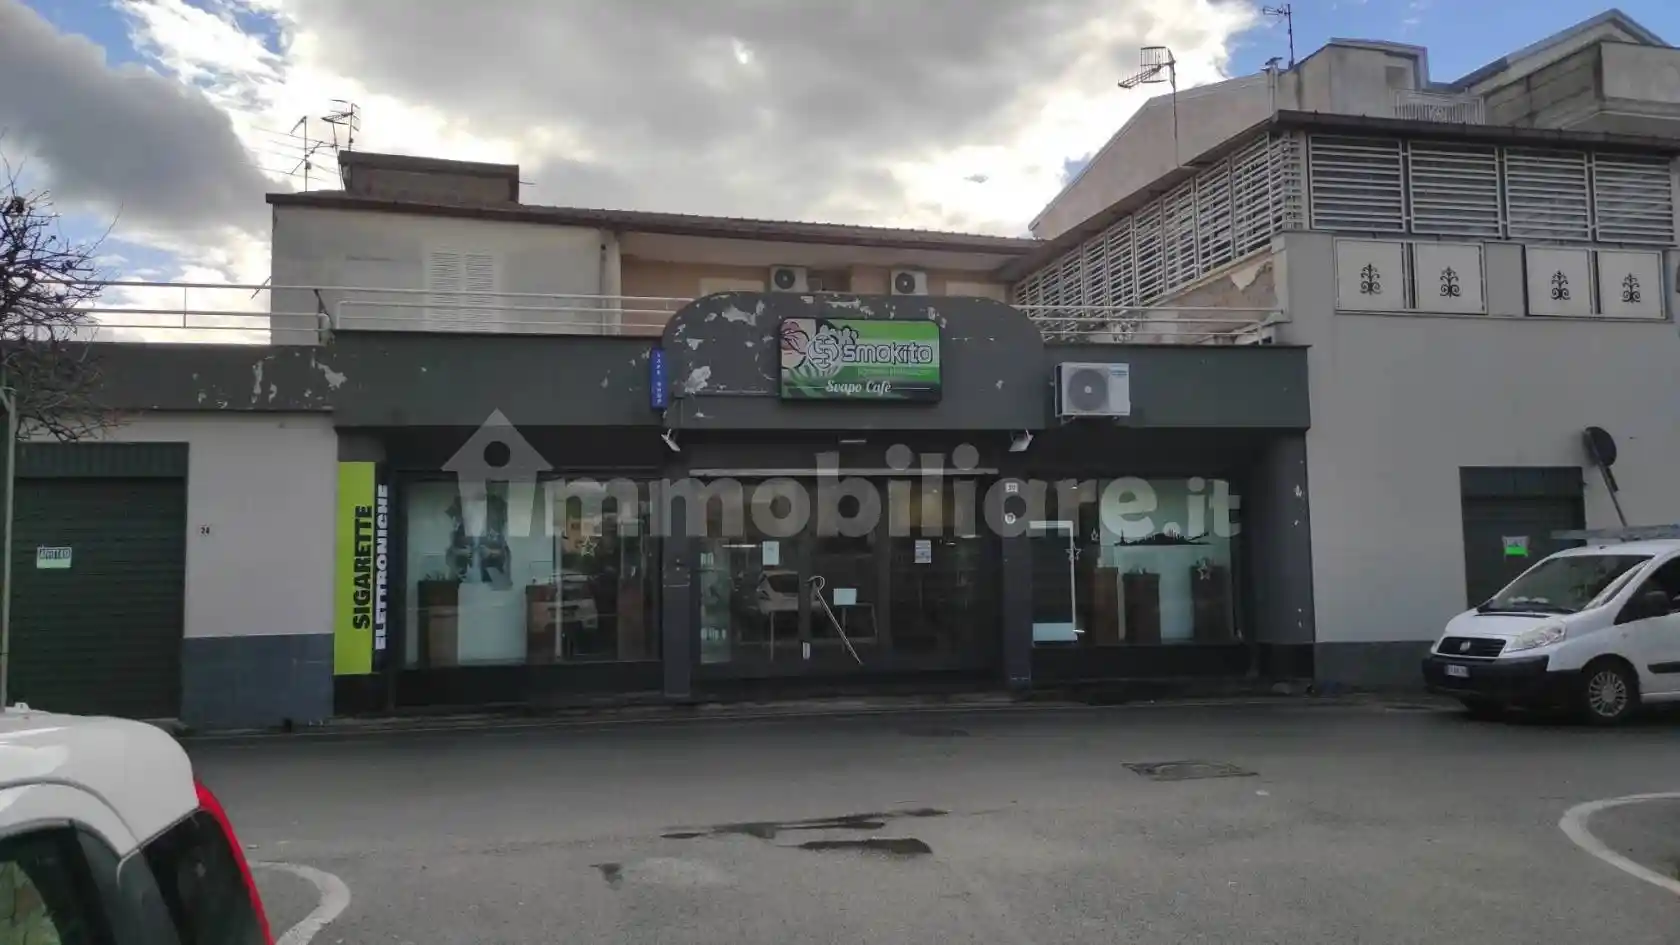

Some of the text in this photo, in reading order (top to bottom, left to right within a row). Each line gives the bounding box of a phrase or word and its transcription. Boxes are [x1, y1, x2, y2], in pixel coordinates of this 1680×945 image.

[826, 380, 862, 395] Svapo
[842, 342, 933, 364] smokito
[352, 505, 373, 630] SIGARETTE
[375, 484, 388, 650] ELETTRONICHE
